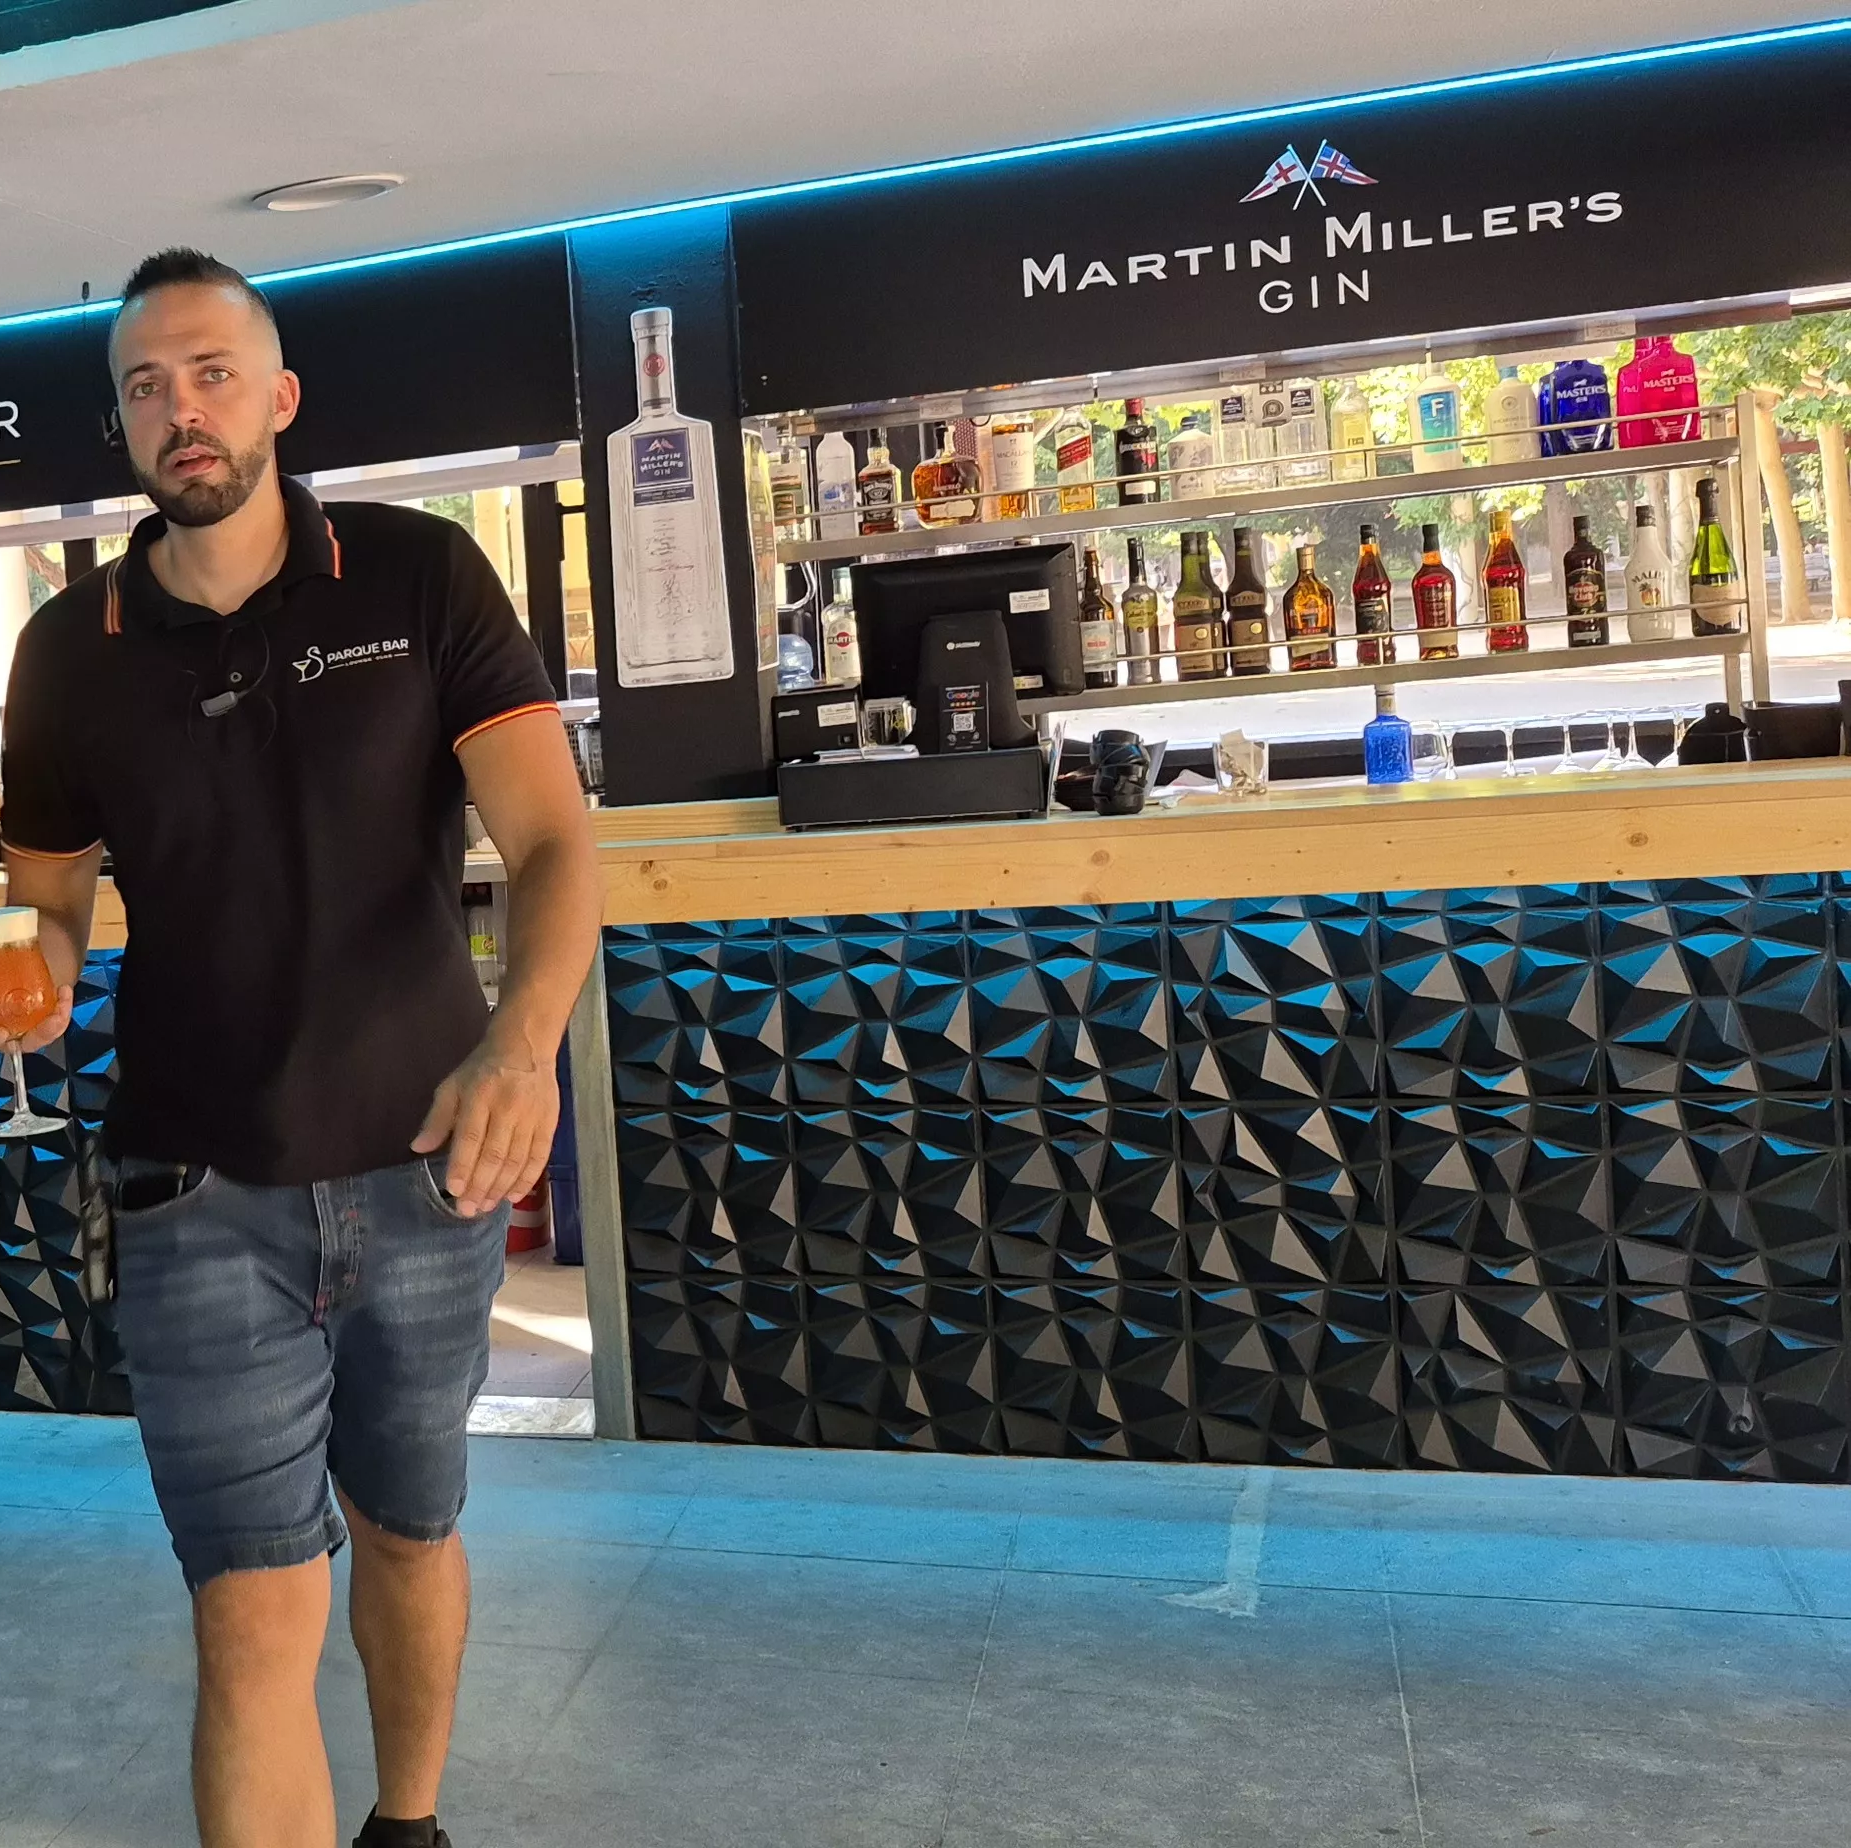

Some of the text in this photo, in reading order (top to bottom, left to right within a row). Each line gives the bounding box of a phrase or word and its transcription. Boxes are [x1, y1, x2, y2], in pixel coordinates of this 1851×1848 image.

[1022, 191, 1624, 298] MARTIN MILLER'S
[1258, 269, 1370, 314] GIN
[327, 642, 380, 664] PARQUE
[382, 638, 409, 652] BAR
